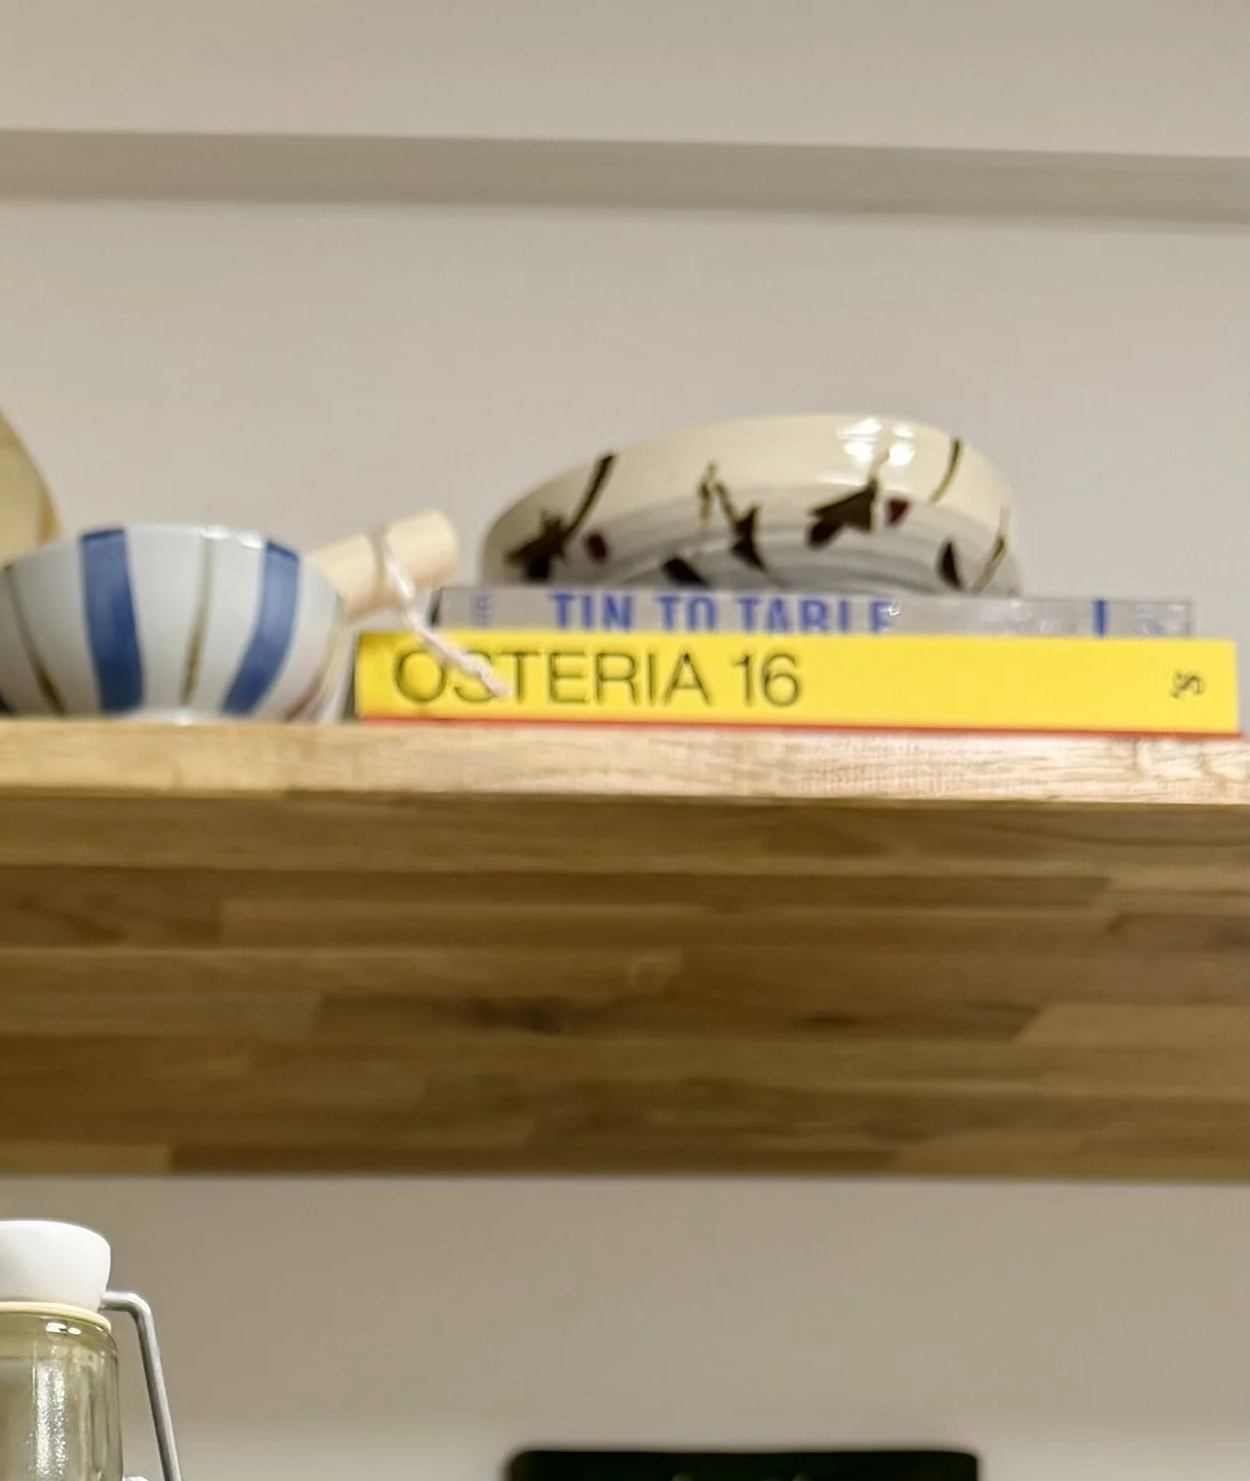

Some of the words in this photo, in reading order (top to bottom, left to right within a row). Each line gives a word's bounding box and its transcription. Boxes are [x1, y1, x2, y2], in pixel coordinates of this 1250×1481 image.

[551, 591, 634, 631] TIN
[656, 594, 719, 633] TO
[729, 651, 802, 709] 16
